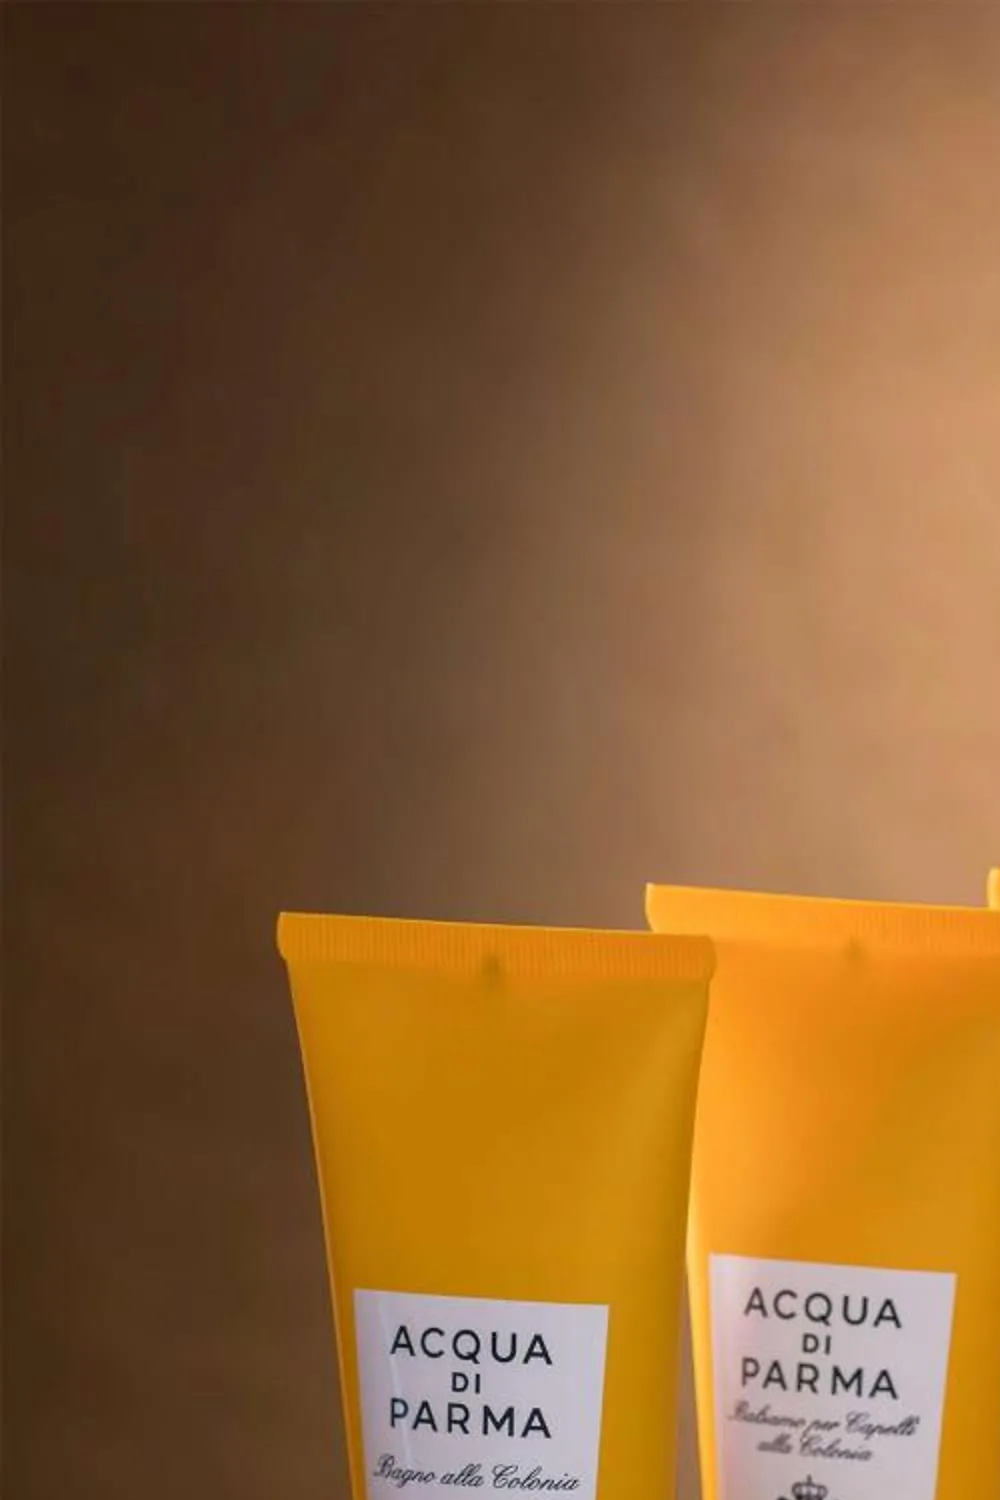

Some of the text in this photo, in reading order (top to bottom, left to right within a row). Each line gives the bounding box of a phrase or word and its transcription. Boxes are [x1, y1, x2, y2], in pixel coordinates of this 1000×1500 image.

[744, 1287, 902, 1329] ACQUA
[391, 1325, 553, 1365] ACQUA
[802, 1333, 831, 1355] DI
[451, 1372, 481, 1394] DI
[741, 1357, 899, 1400] PARMA
[390, 1398, 551, 1439] PARMA
[799, 1435, 873, 1461] Colonia
[373, 1453, 580, 1491] Bagno alla Colonia
